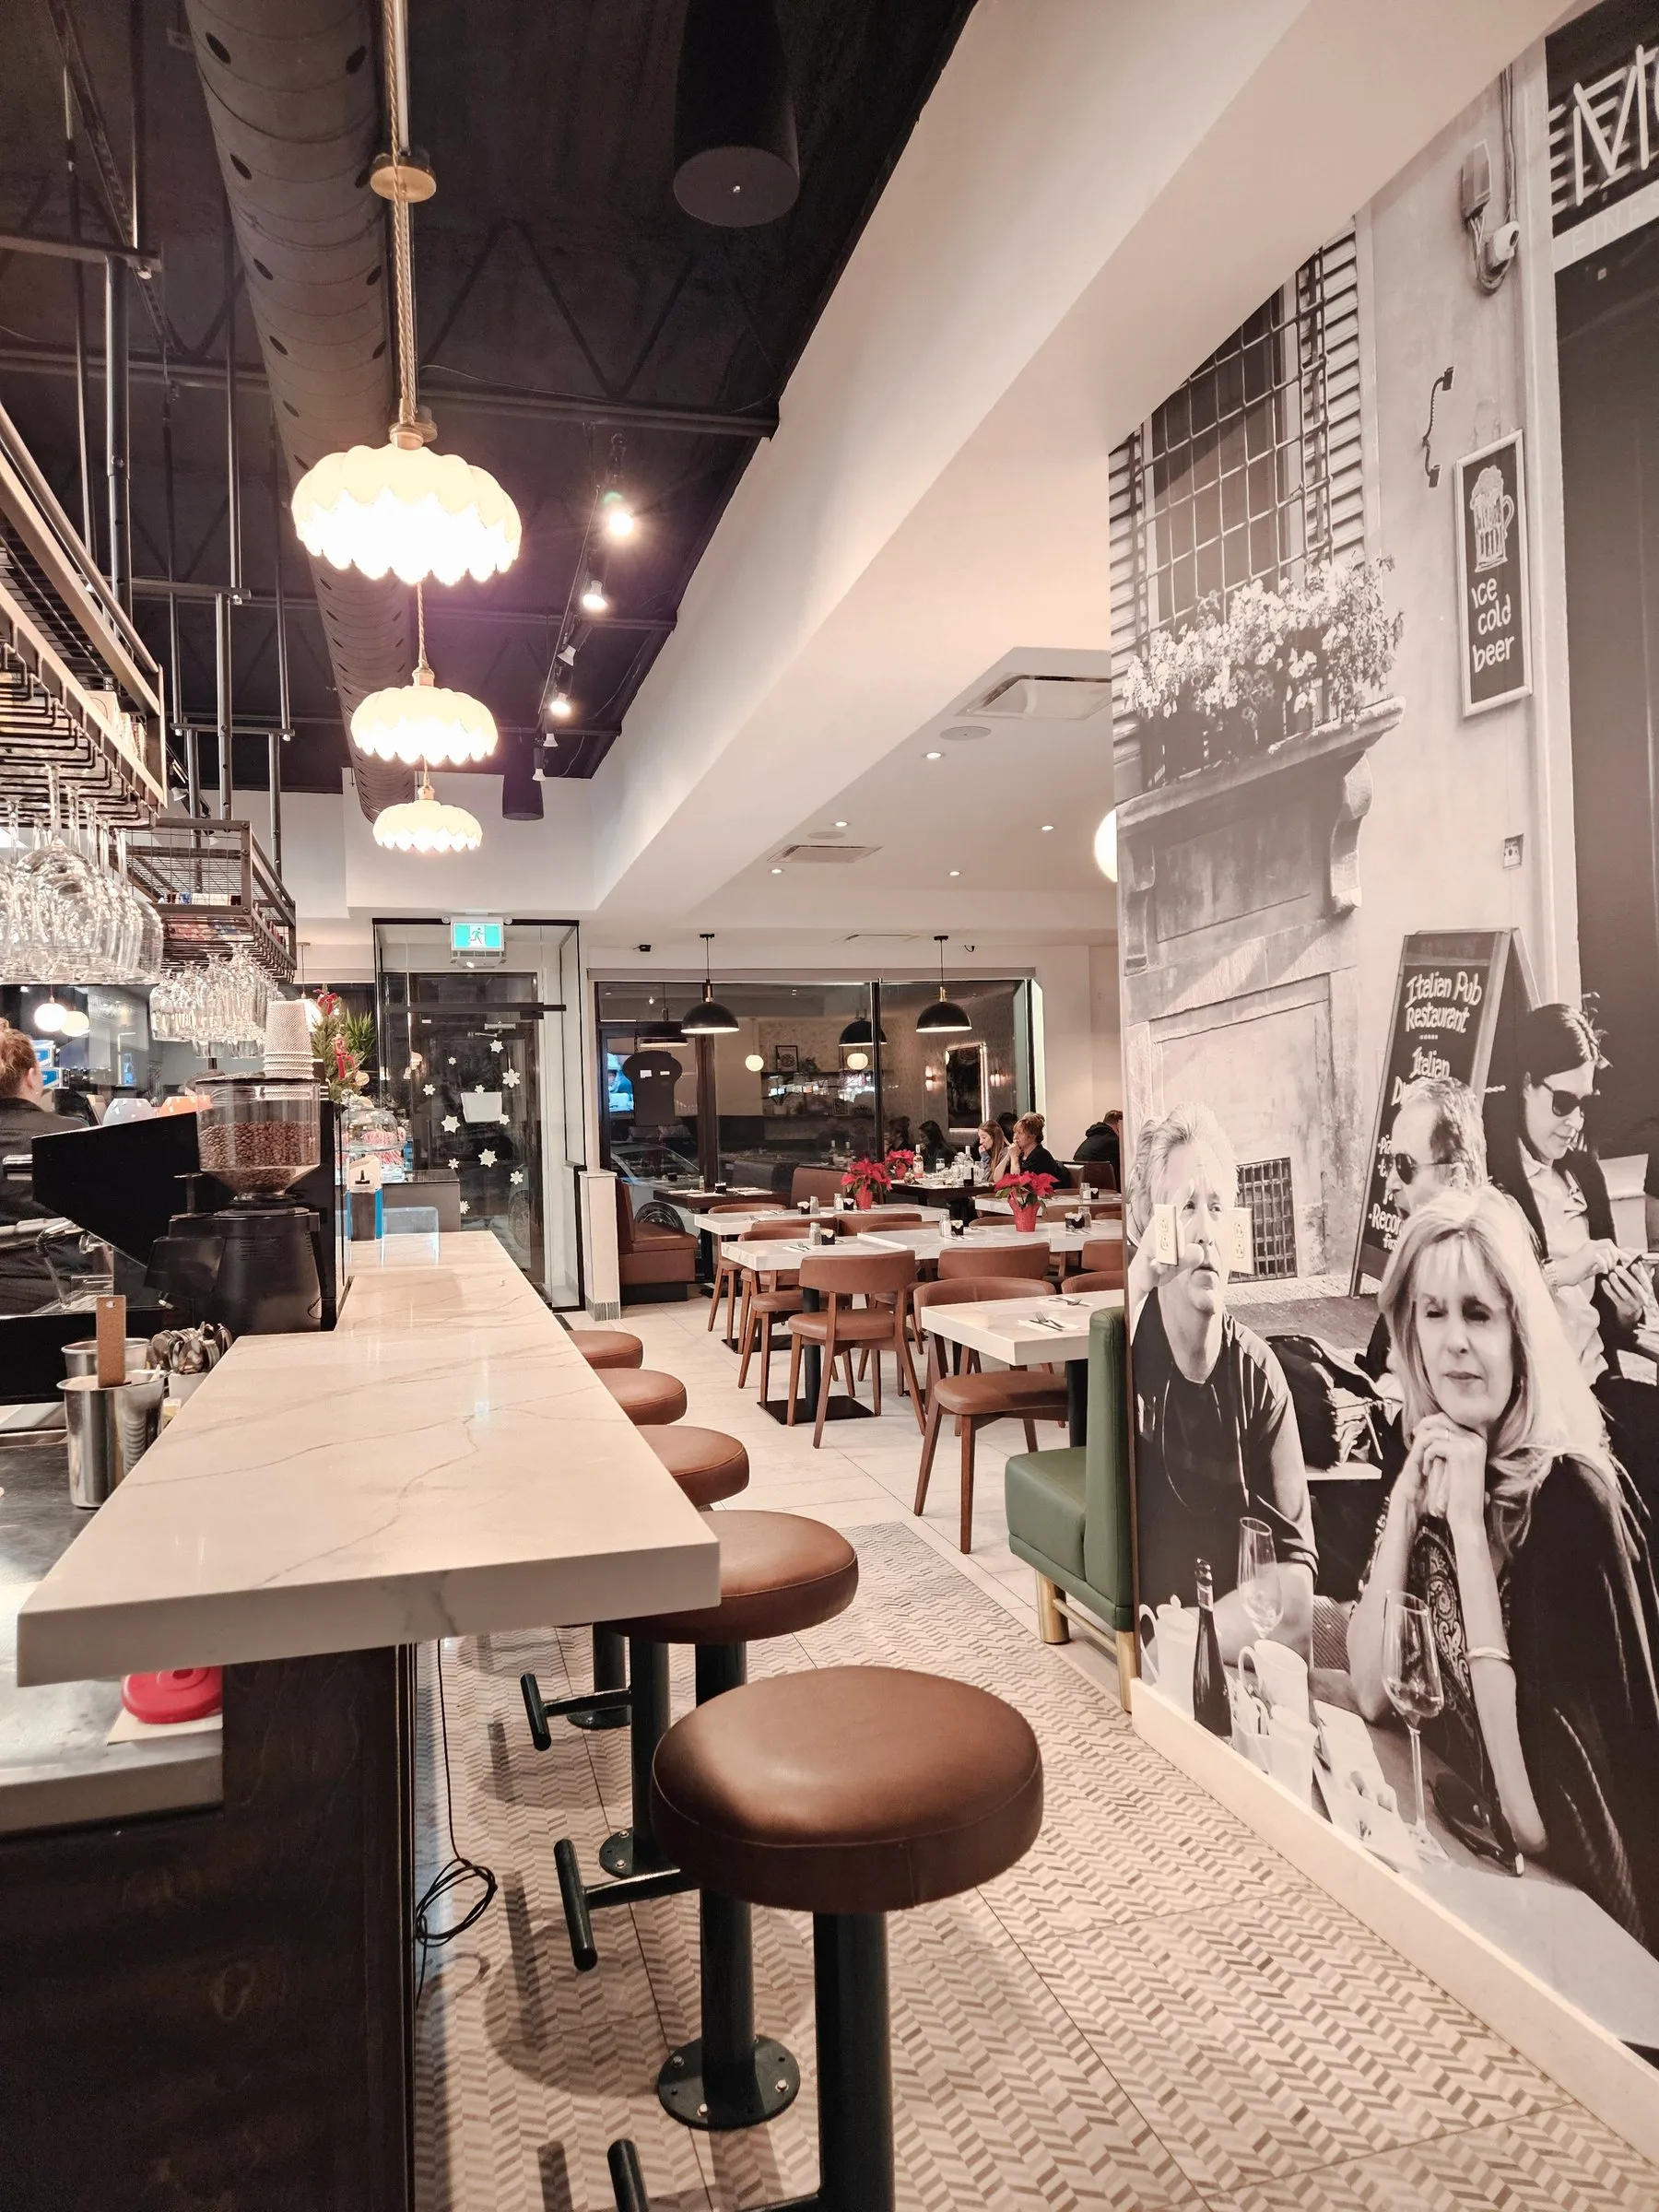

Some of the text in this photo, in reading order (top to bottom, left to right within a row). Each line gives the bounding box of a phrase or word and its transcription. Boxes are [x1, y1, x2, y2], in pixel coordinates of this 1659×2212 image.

[1477, 594, 1512, 636] cold
[1472, 636, 1515, 673] beer
[1405, 971, 1482, 1008] Italian Pub
[1405, 1002, 1471, 1034] Restaurant
[1408, 1046, 1451, 1079] Italian
